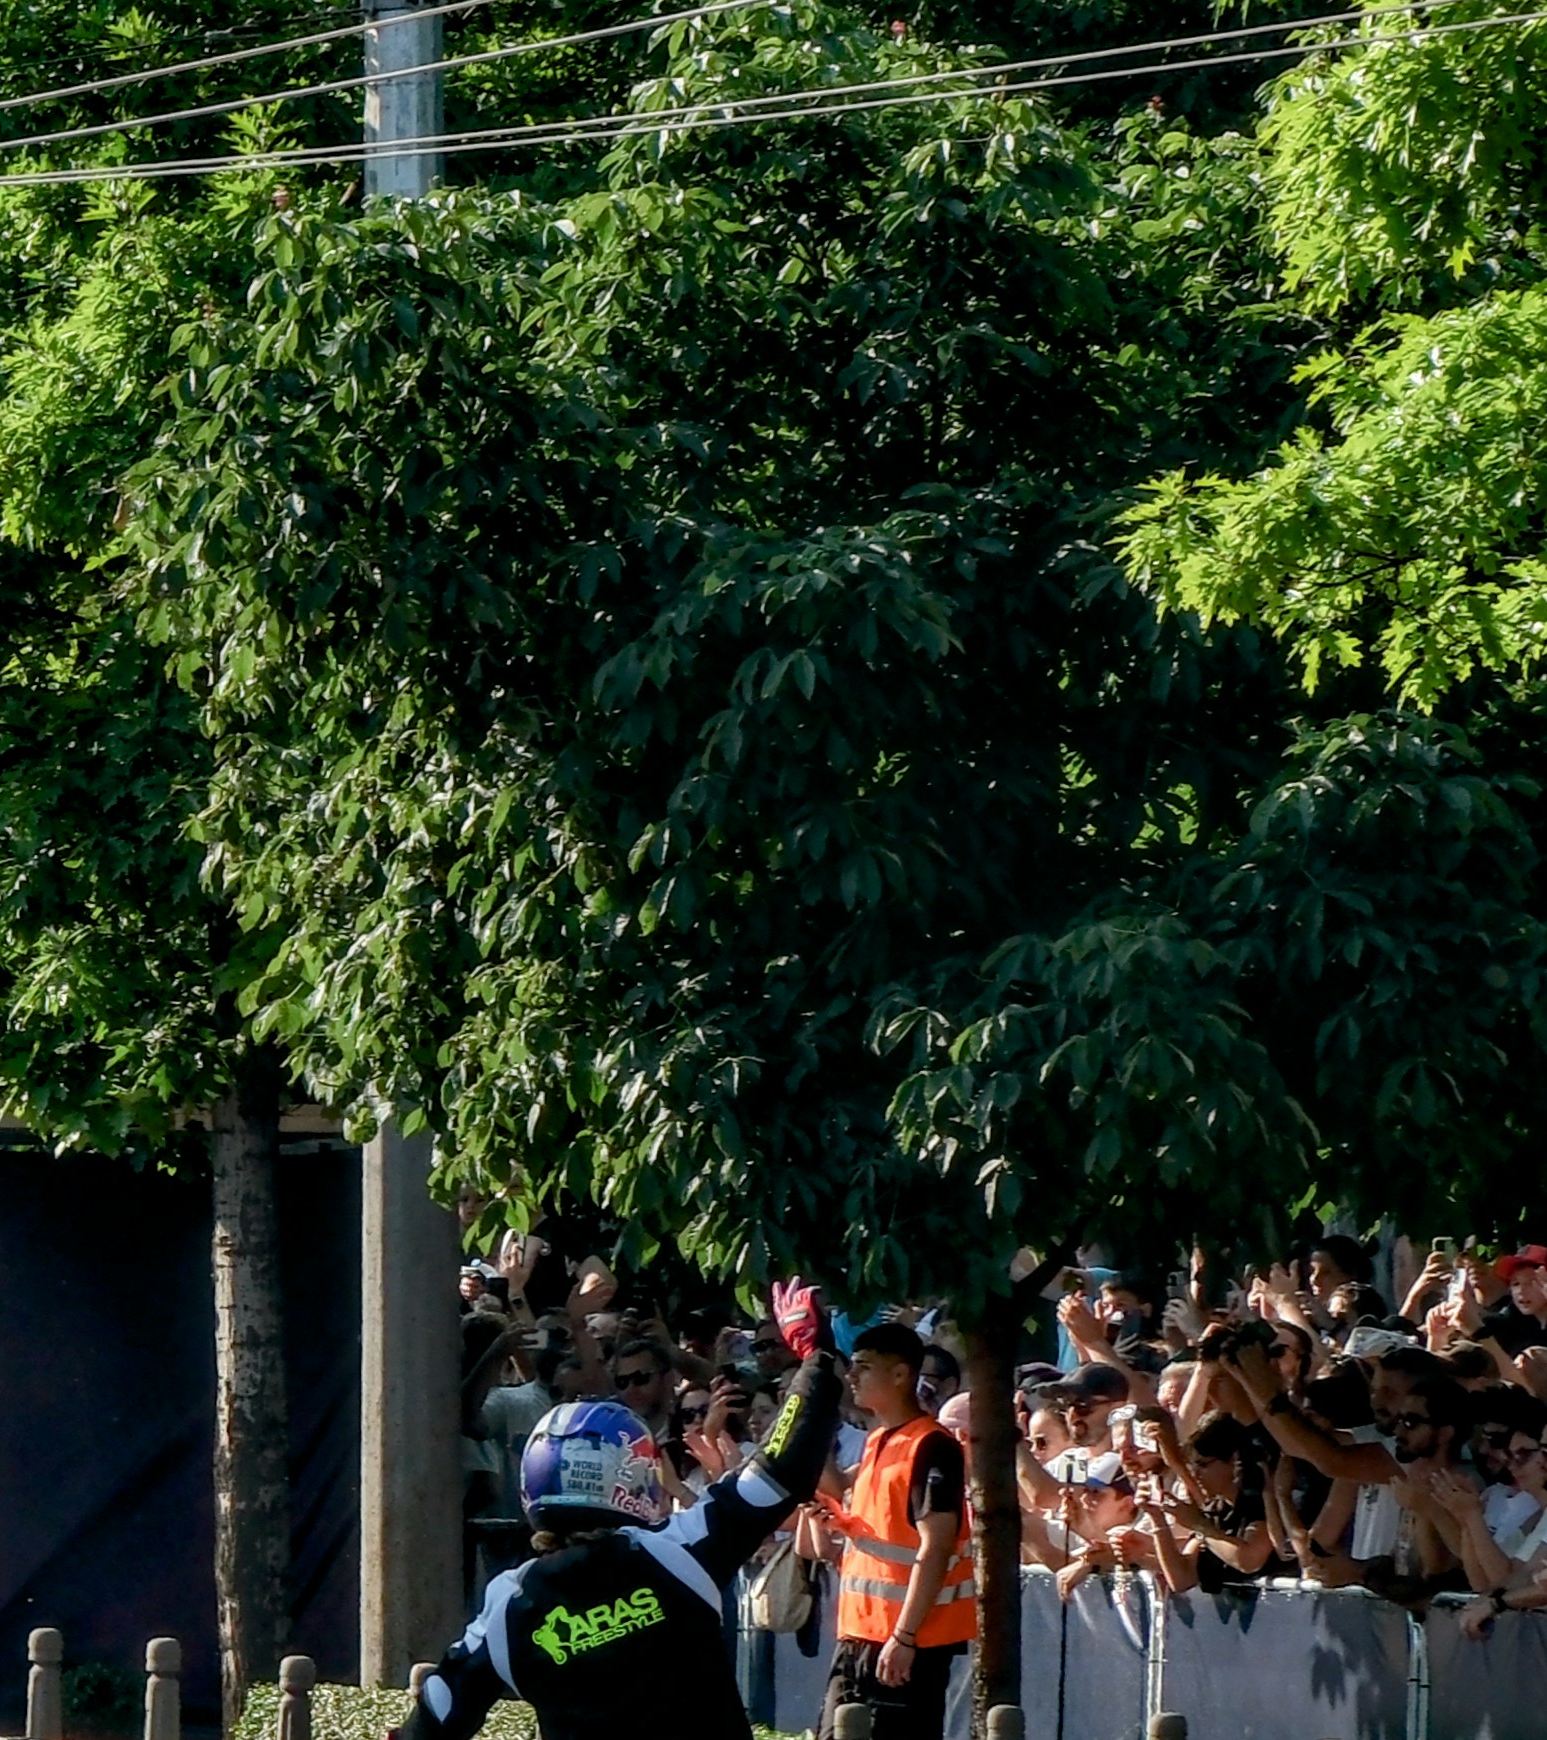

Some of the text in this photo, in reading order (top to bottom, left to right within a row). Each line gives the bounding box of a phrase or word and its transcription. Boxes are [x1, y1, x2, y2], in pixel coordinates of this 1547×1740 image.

[570, 1470, 604, 1481] RECORD
[573, 1460, 603, 1471] WORLD
[570, 1588, 659, 1643] ARAS
[571, 1607, 666, 1655] FREESTYLE
